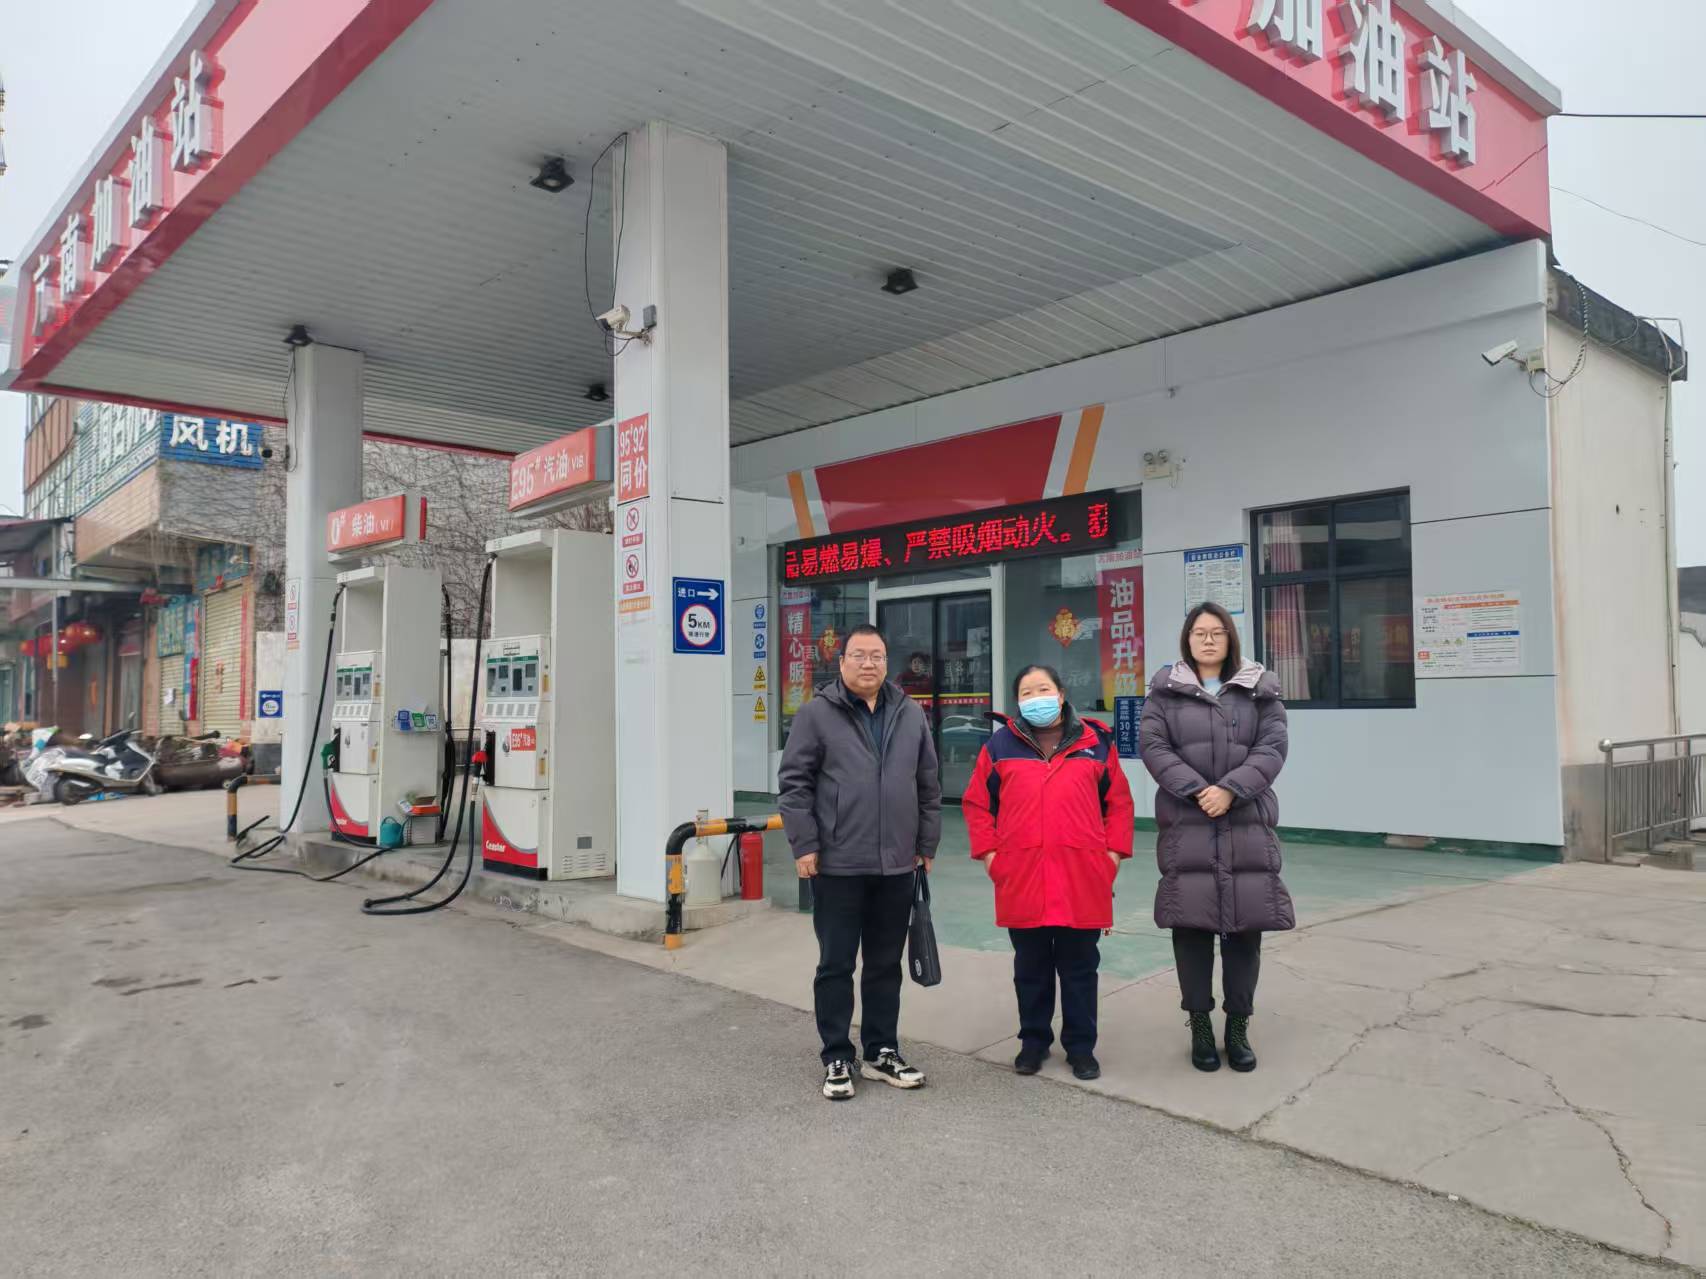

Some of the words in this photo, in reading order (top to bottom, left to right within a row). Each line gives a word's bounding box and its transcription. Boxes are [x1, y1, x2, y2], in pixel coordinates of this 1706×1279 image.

[170, 415, 253, 456] 风机
[620, 456, 648, 495] 同价
[687, 613, 711, 629] 5KM
